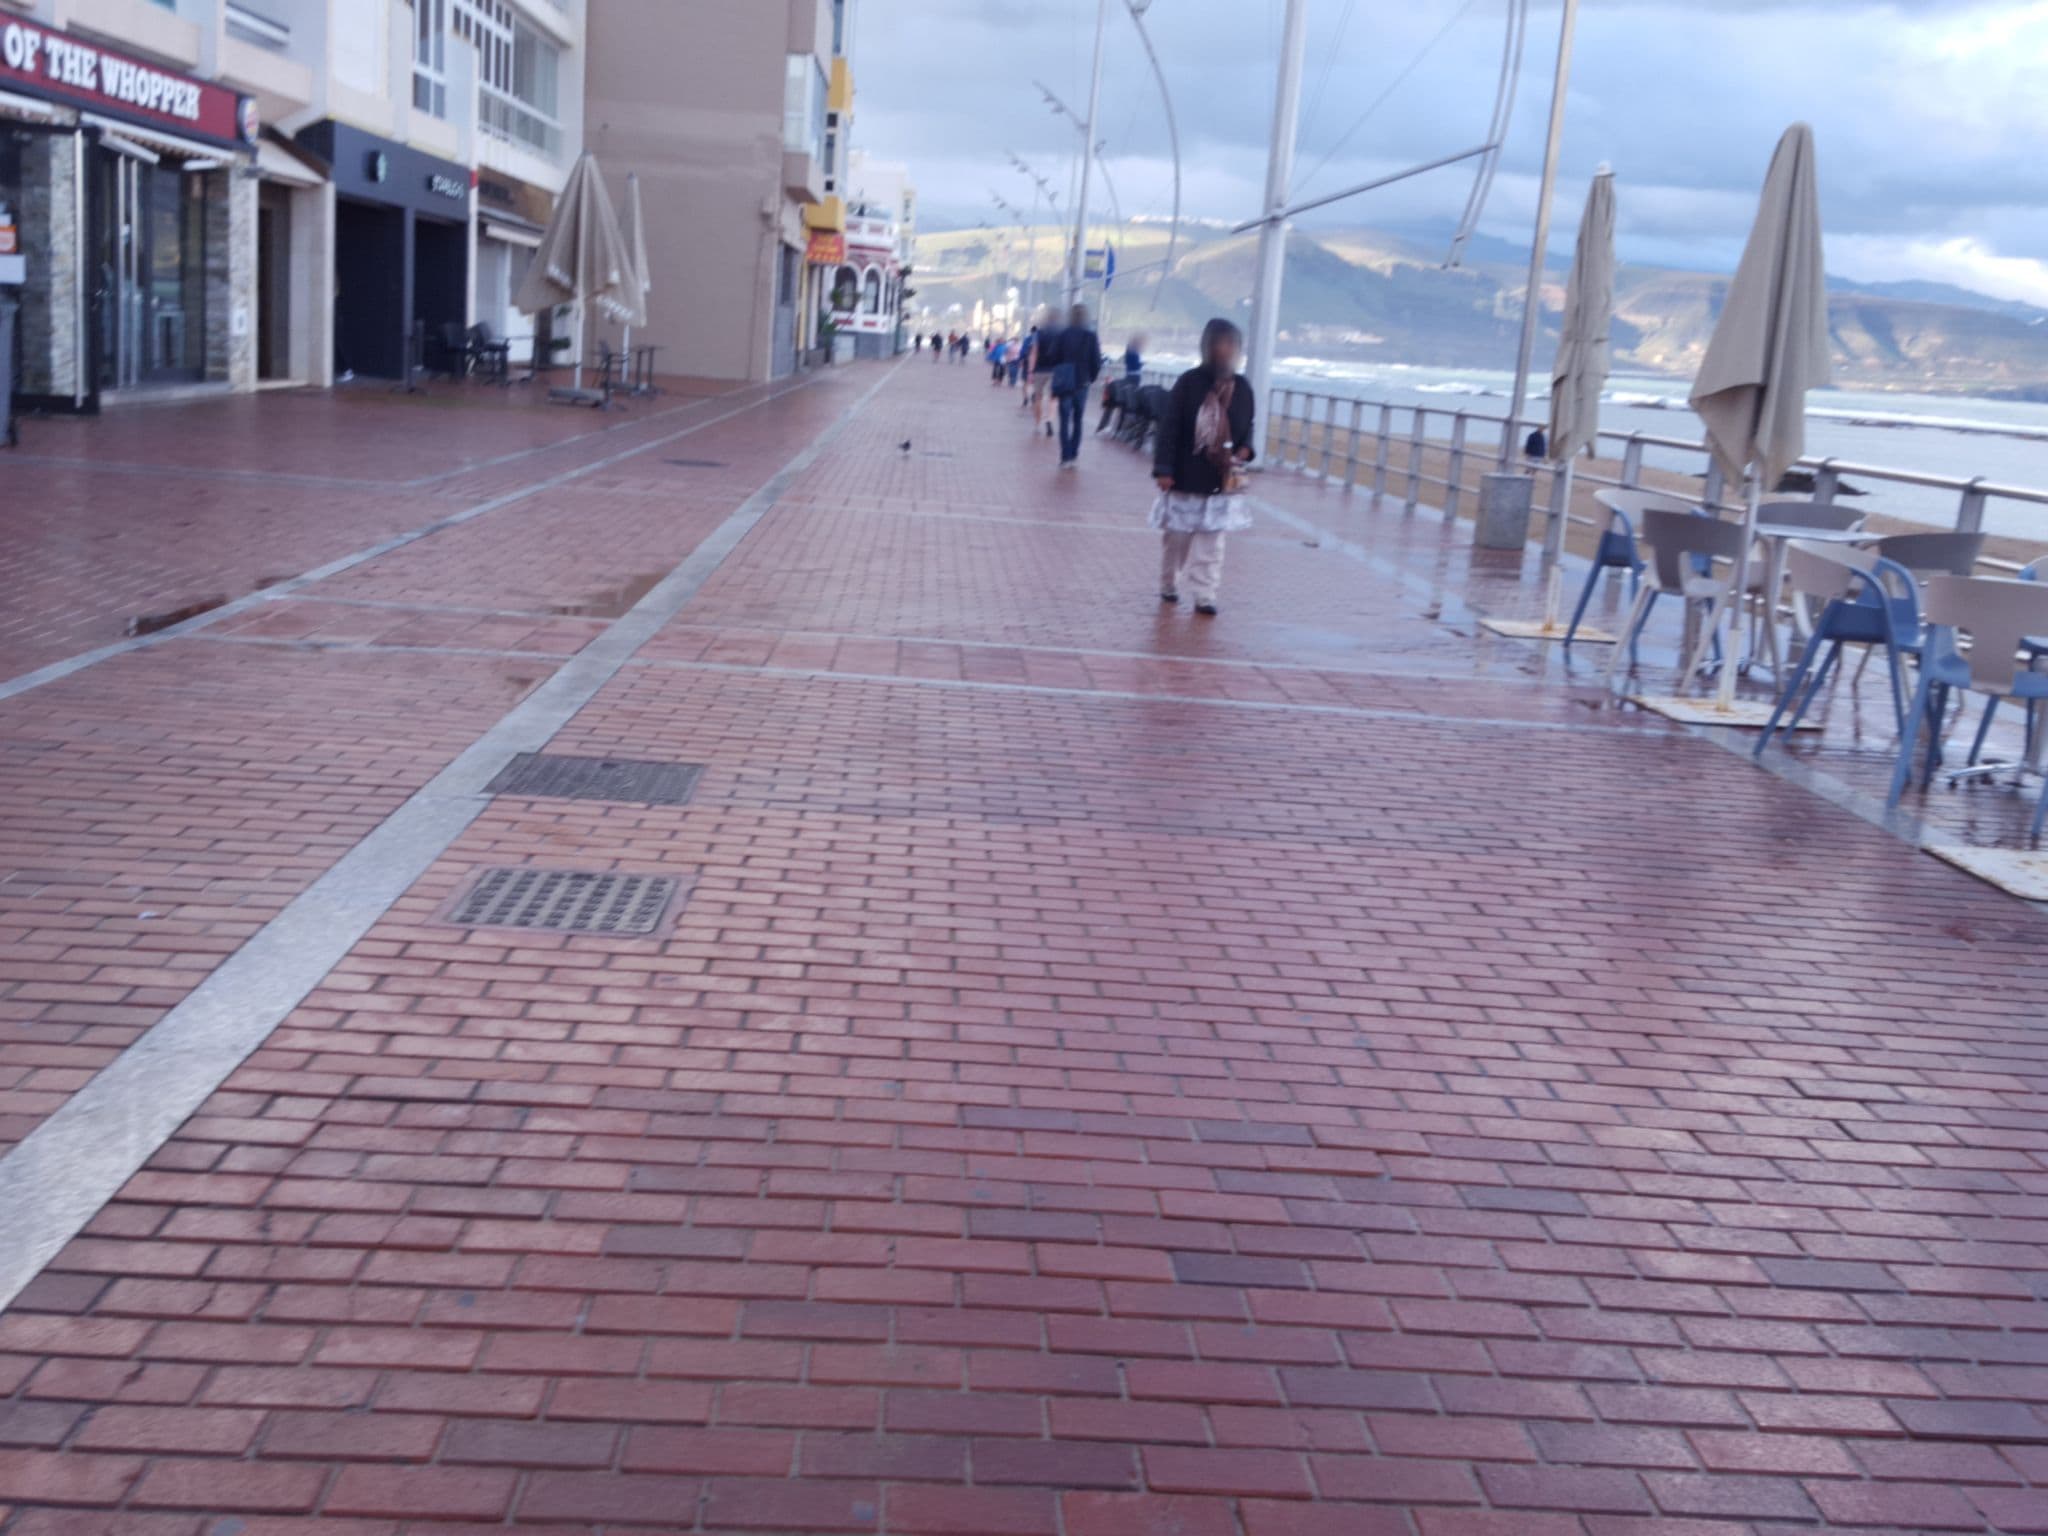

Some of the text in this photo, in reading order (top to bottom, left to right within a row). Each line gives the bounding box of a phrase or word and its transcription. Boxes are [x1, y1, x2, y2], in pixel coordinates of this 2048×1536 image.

[4, 23, 201, 120] OF THE WHOPPER
